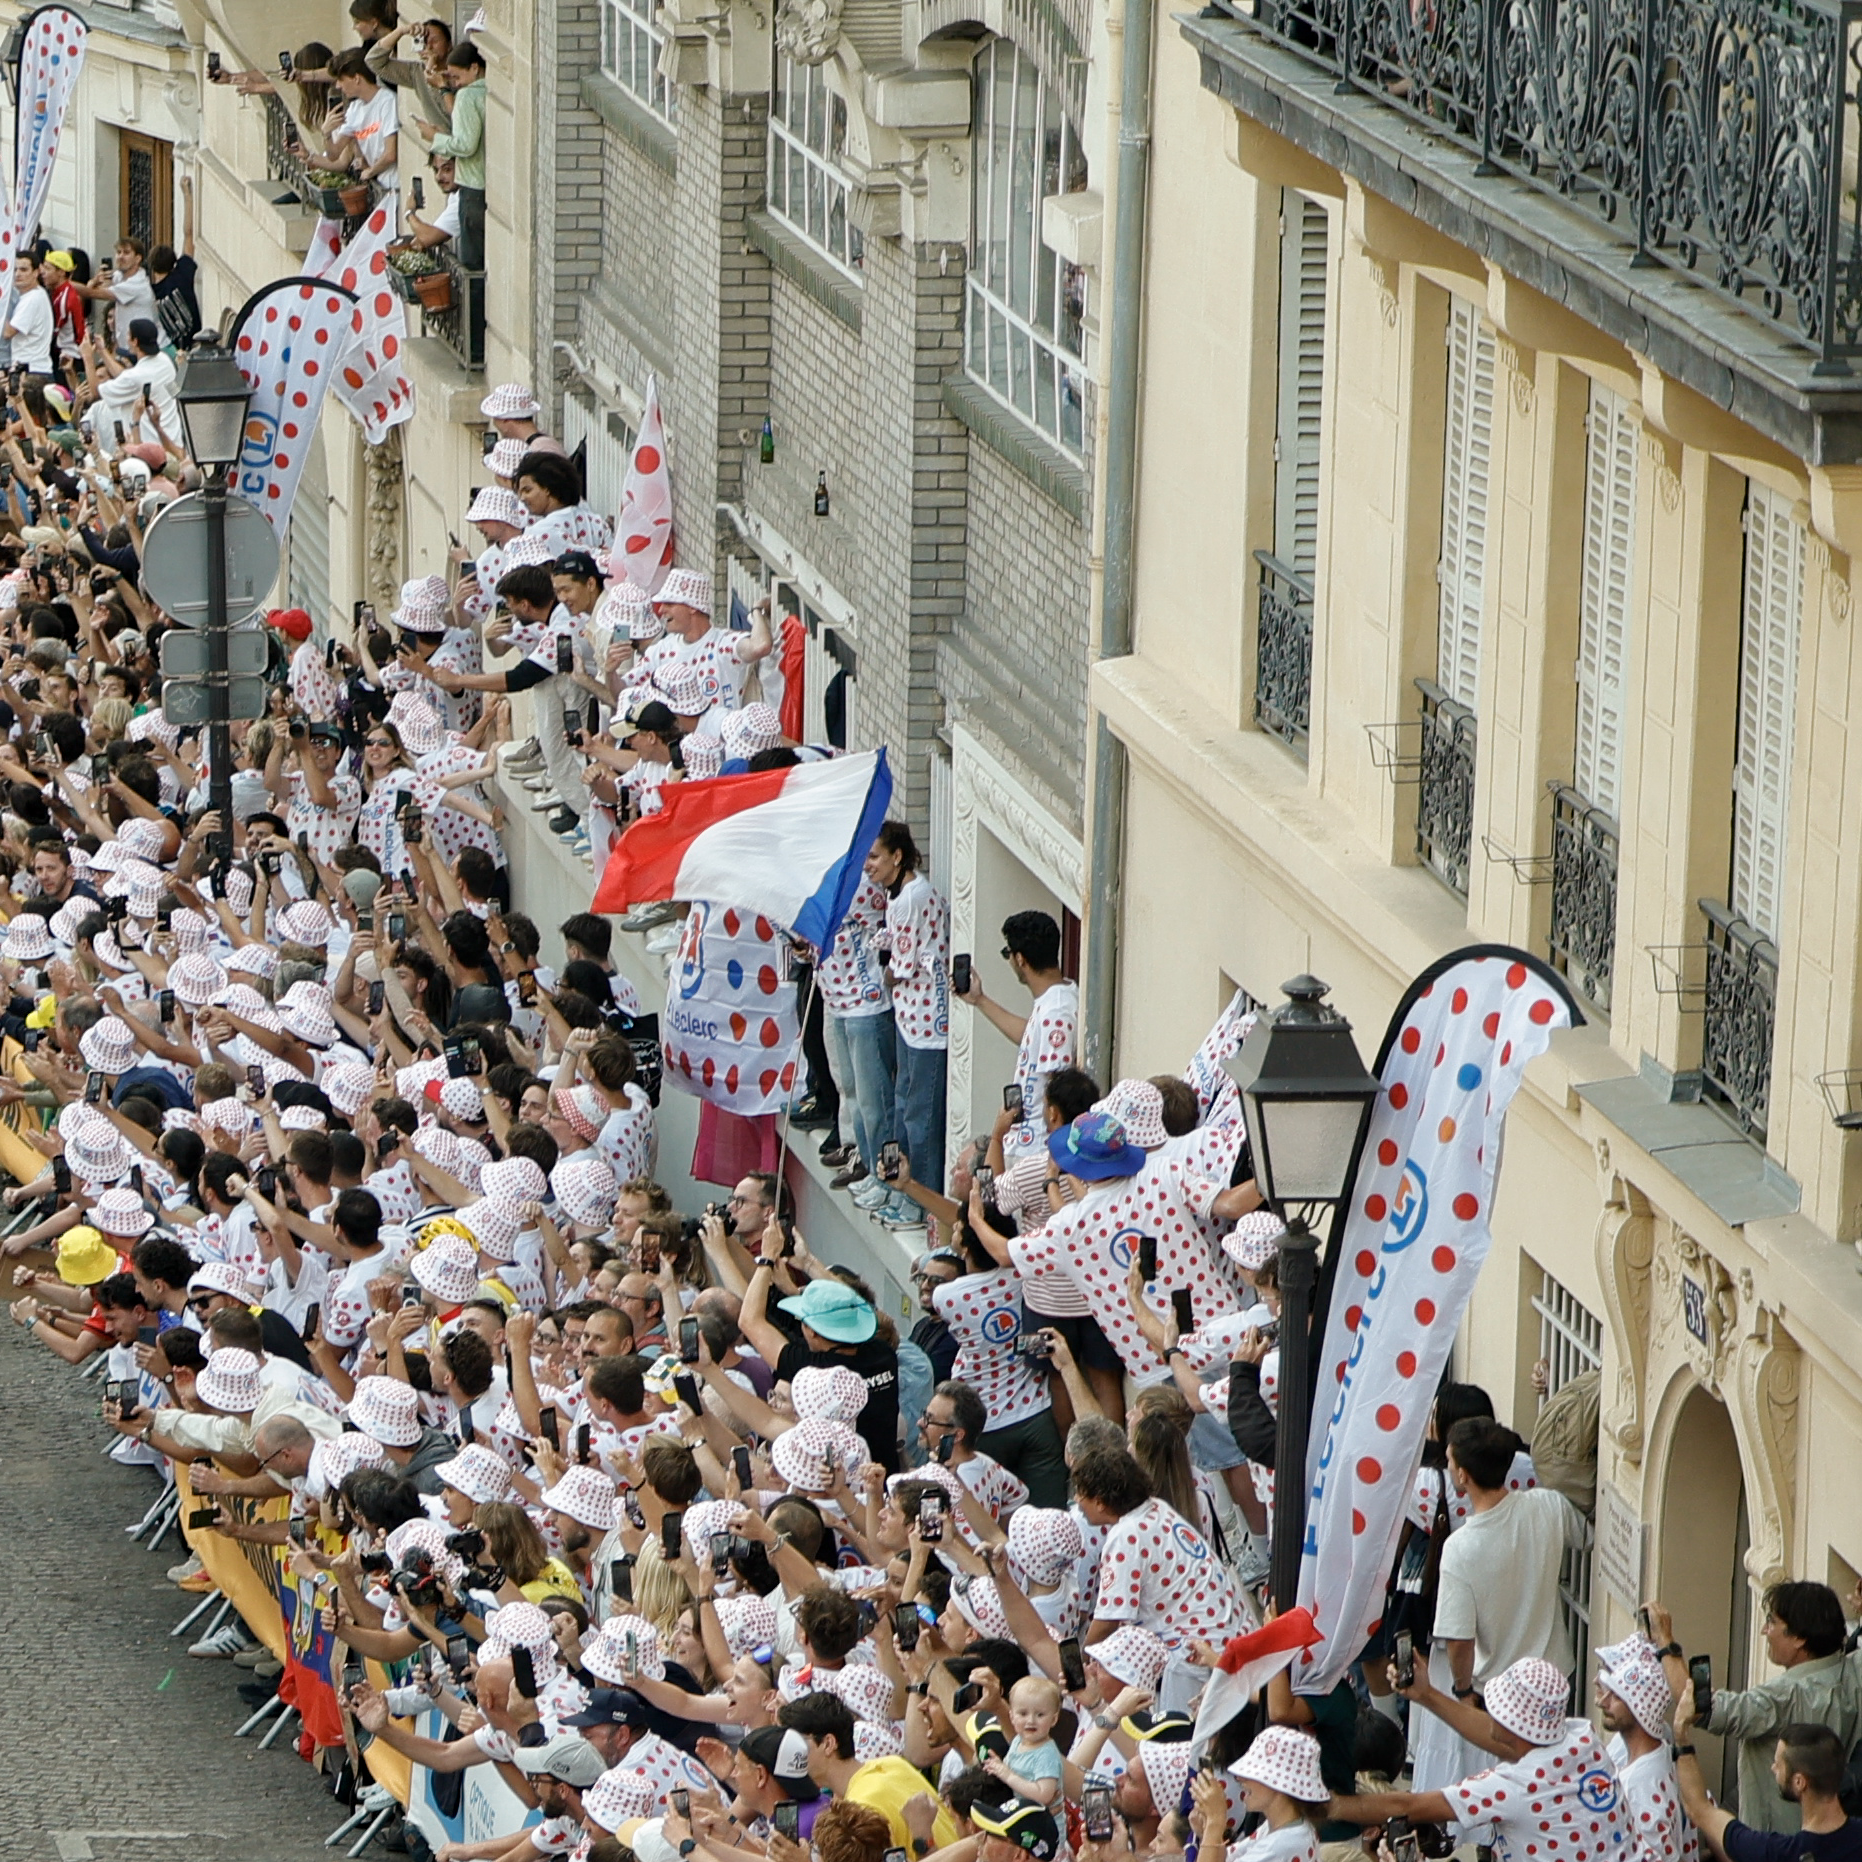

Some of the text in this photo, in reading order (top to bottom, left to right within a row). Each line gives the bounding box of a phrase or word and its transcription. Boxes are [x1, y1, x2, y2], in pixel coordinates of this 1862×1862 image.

[934, 958, 947, 1014] eclerc
[1687, 1297, 1703, 1338] 53
[469, 1780, 496, 1833] OPTIQUE
